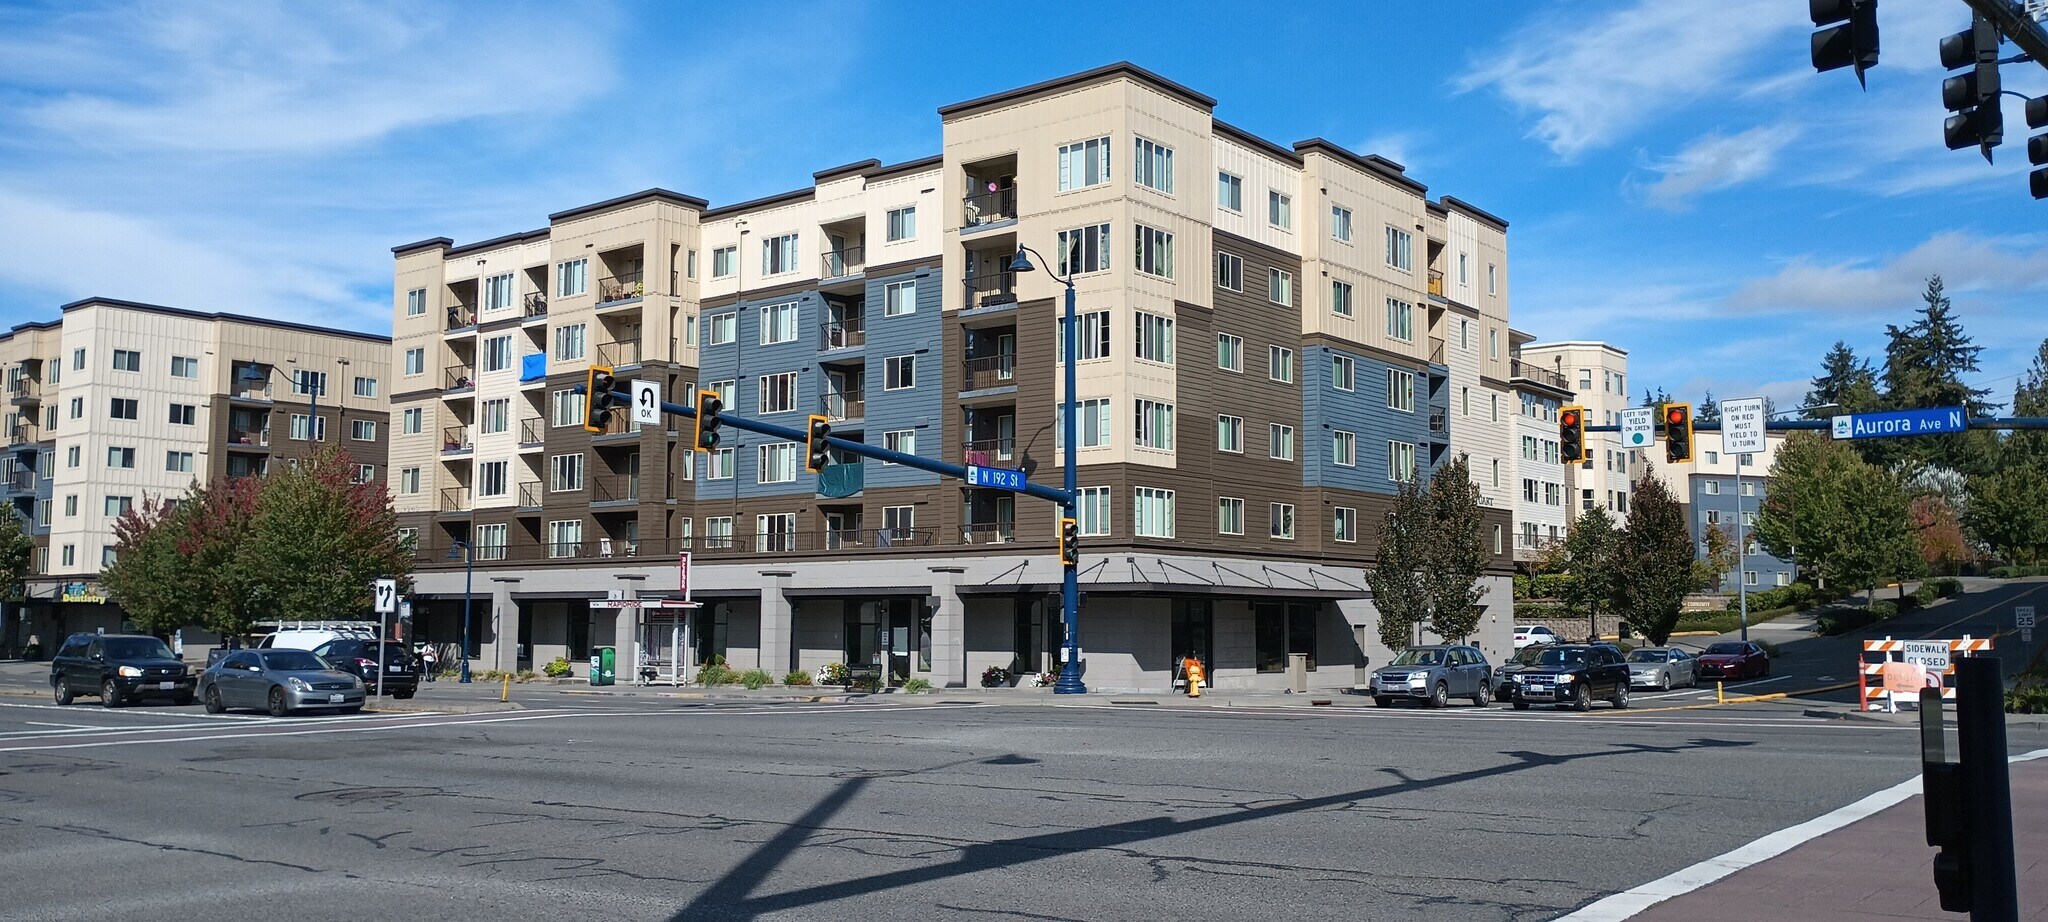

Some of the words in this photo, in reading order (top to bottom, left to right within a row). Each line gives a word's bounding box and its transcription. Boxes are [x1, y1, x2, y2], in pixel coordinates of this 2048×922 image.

[641, 408, 652, 418] OK
[1855, 418, 1911, 434] Aurora
[1919, 419, 1941, 430] Ave
[1949, 411, 1961, 428] N
[983, 470, 989, 483] N
[993, 472, 1006, 485] 192
[1010, 473, 1018, 487] St
[63, 593, 106, 605] Dentistry
[2018, 617, 2034, 625] 25
[1906, 644, 1947, 654] SIDEWALK
